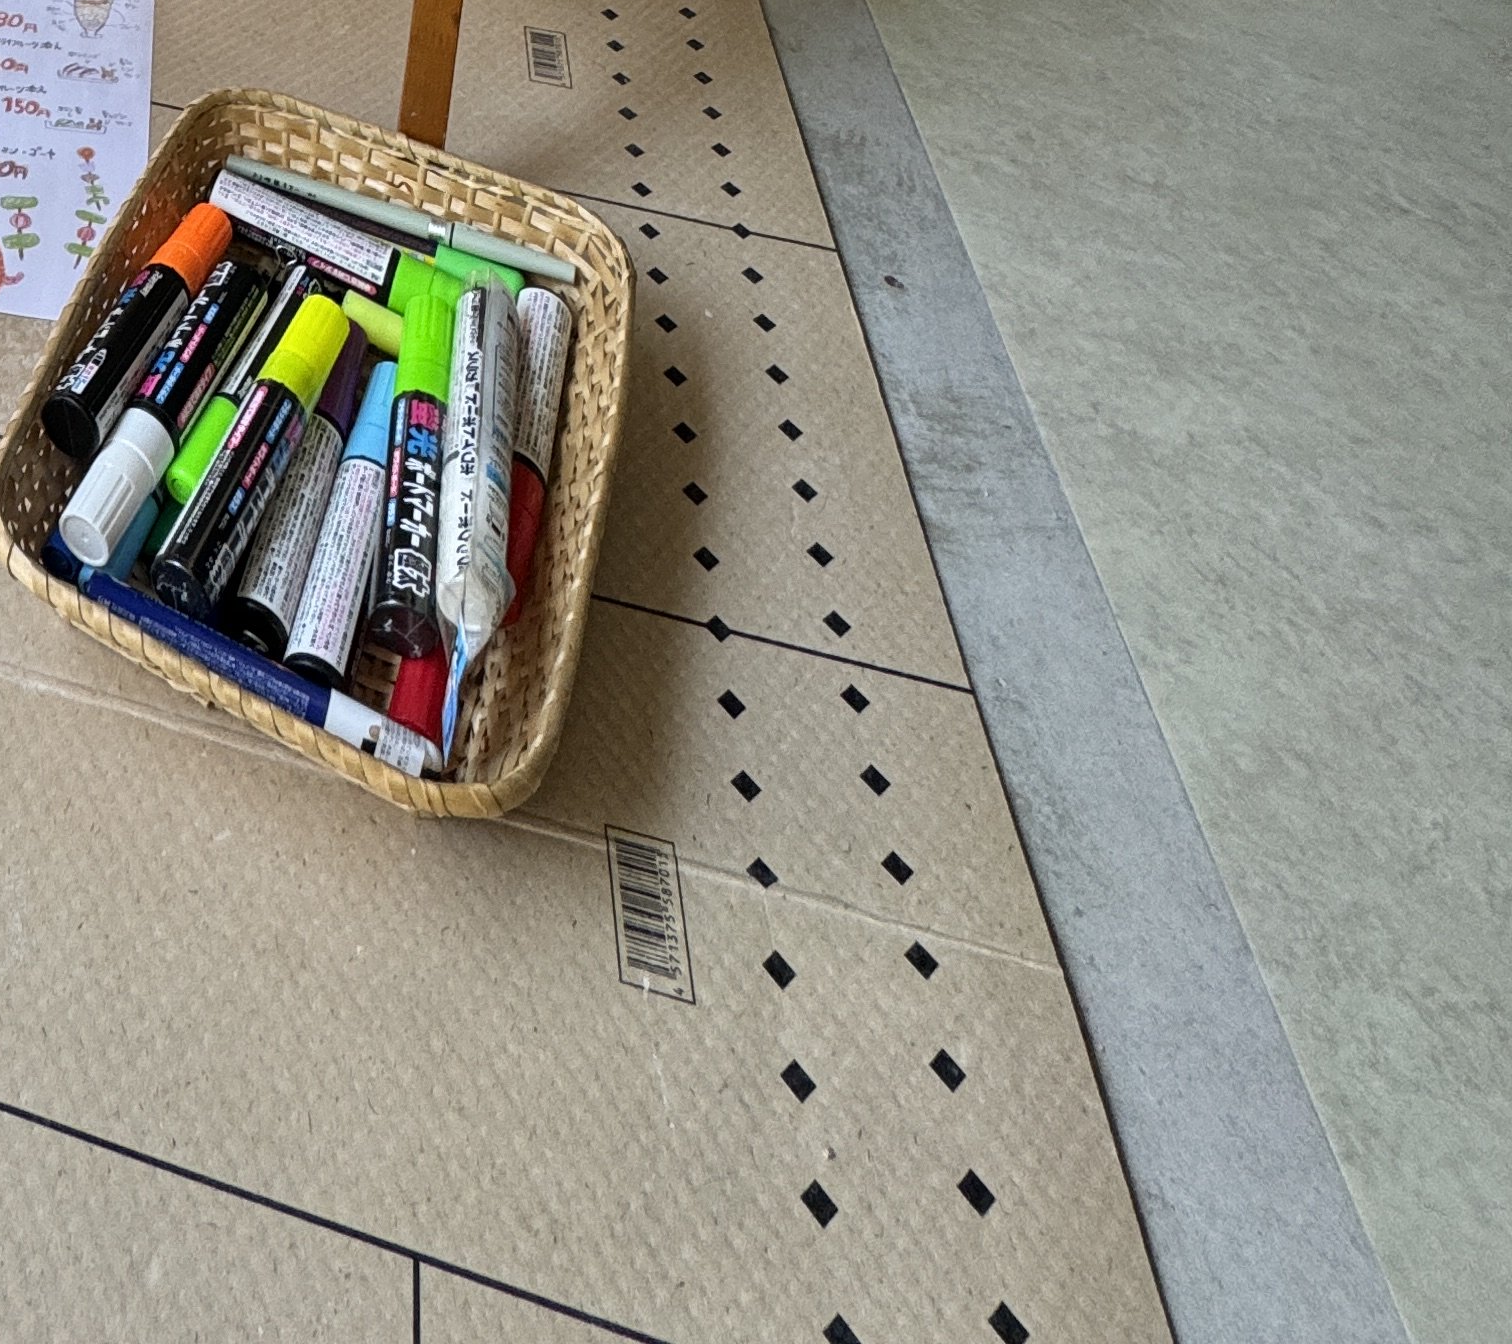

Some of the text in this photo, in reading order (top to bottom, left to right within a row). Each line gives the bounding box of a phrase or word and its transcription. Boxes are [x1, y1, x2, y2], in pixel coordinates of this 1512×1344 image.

[1, 96, 51, 118] 150円
[399, 398, 440, 548] 蛍光ボードマーカー
